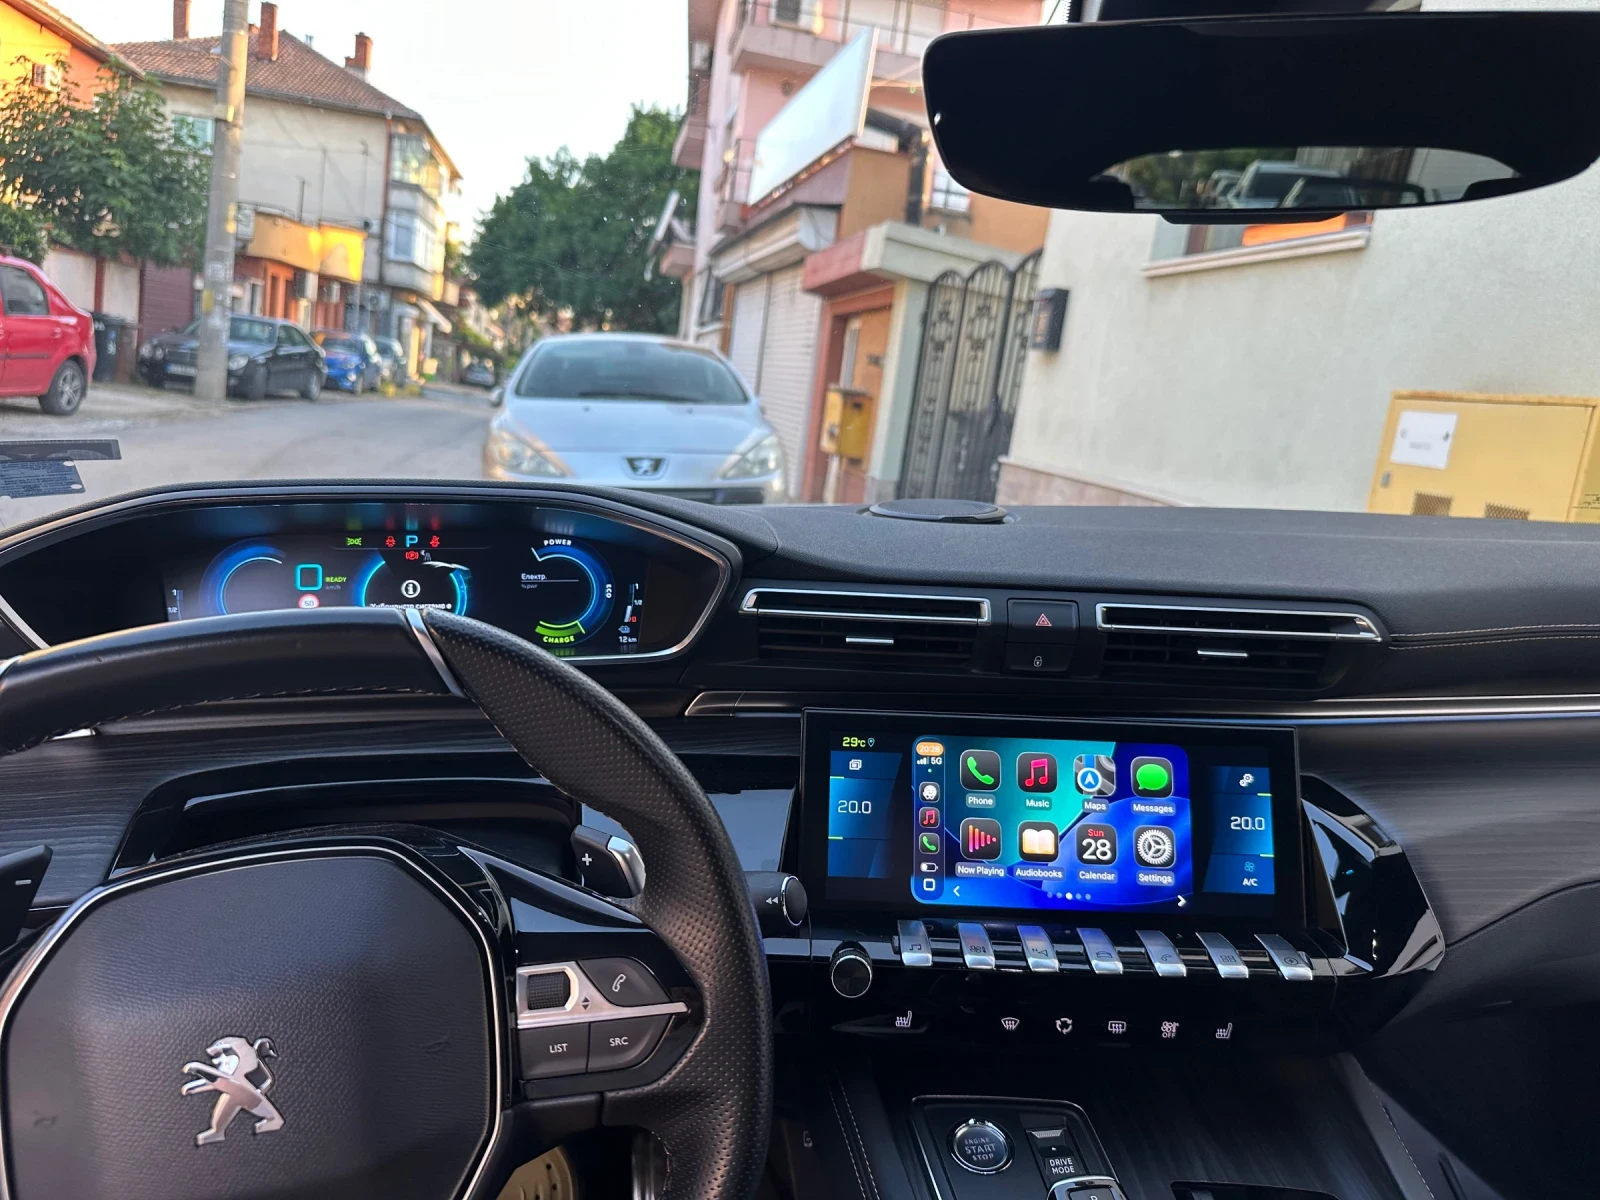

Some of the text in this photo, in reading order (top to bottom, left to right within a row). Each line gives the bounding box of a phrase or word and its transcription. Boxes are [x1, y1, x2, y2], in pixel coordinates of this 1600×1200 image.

[405, 535, 418, 547] P
[543, 538, 572, 546] POWER
[542, 635, 575, 644] CHARGE
[618, 635, 628, 643] 12
[930, 756, 943, 765] 5G
[968, 796, 993, 806] Phone
[1026, 798, 1050, 808] Music
[837, 800, 872, 814] 20.0
[1084, 801, 1107, 812] Maps
[1133, 803, 1174, 814] Messages
[1230, 816, 1265, 831] 20.0
[1087, 828, 1104, 837] Sun
[1081, 838, 1112, 861] 28
[957, 865, 1005, 877] Now Playing
[1015, 867, 1063, 878] Audiobooks
[1079, 870, 1115, 881] Calendar
[1138, 872, 1173, 884] Settings
[1242, 877, 1258, 887] A/C
[1161, 1031, 1176, 1039] OFF
[609, 1036, 629, 1047] SRC
[549, 1043, 568, 1054] LIST
[964, 1136, 990, 1145] ENGINE
[965, 1143, 996, 1154] START
[972, 1153, 994, 1161] STOP
[1049, 1157, 1073, 1166] DRIVE
[1051, 1165, 1075, 1174] MODE
